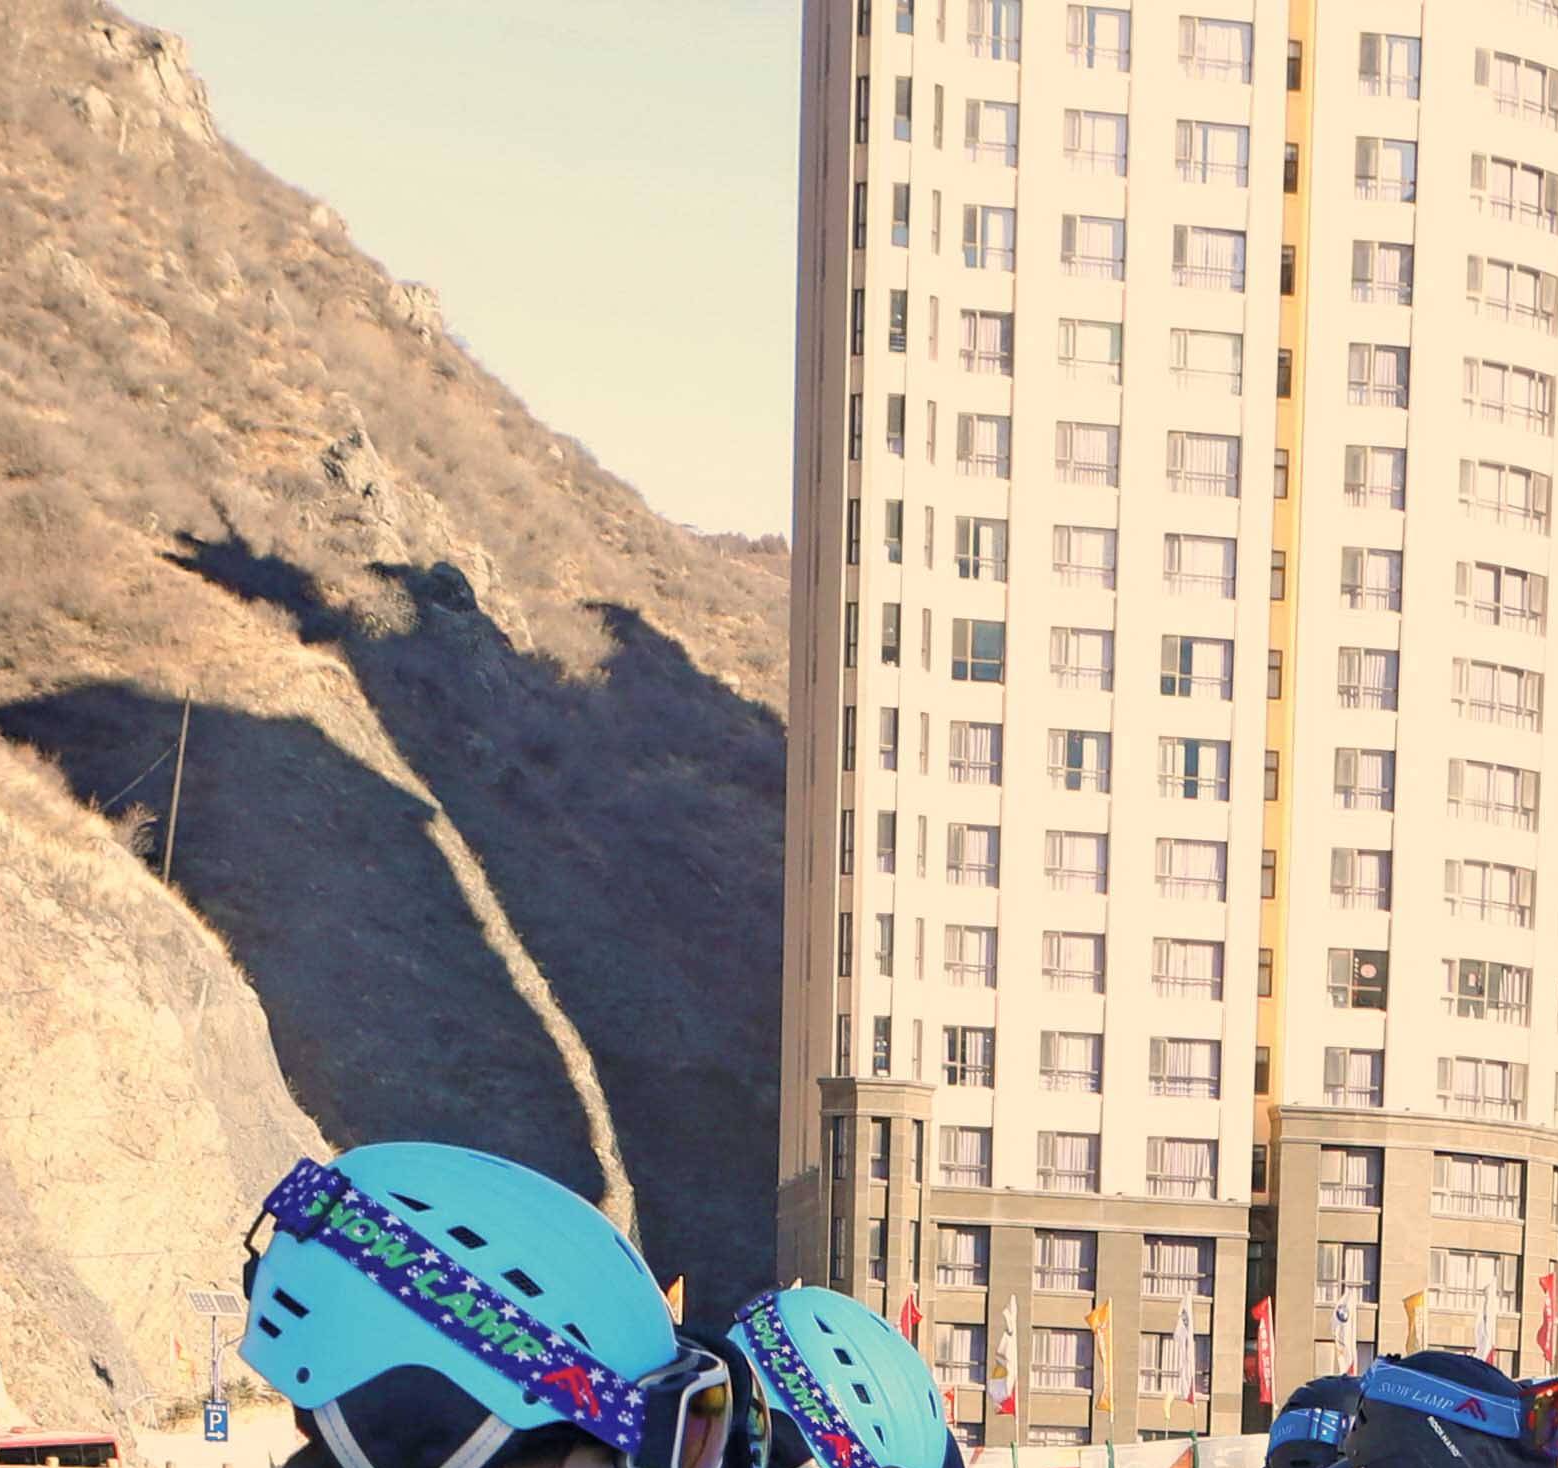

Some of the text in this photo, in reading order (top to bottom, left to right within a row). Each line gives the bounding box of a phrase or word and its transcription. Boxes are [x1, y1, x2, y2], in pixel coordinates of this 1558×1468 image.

[306, 1192, 546, 1357] SNOW LAMP
[209, 1411, 223, 1431] P
